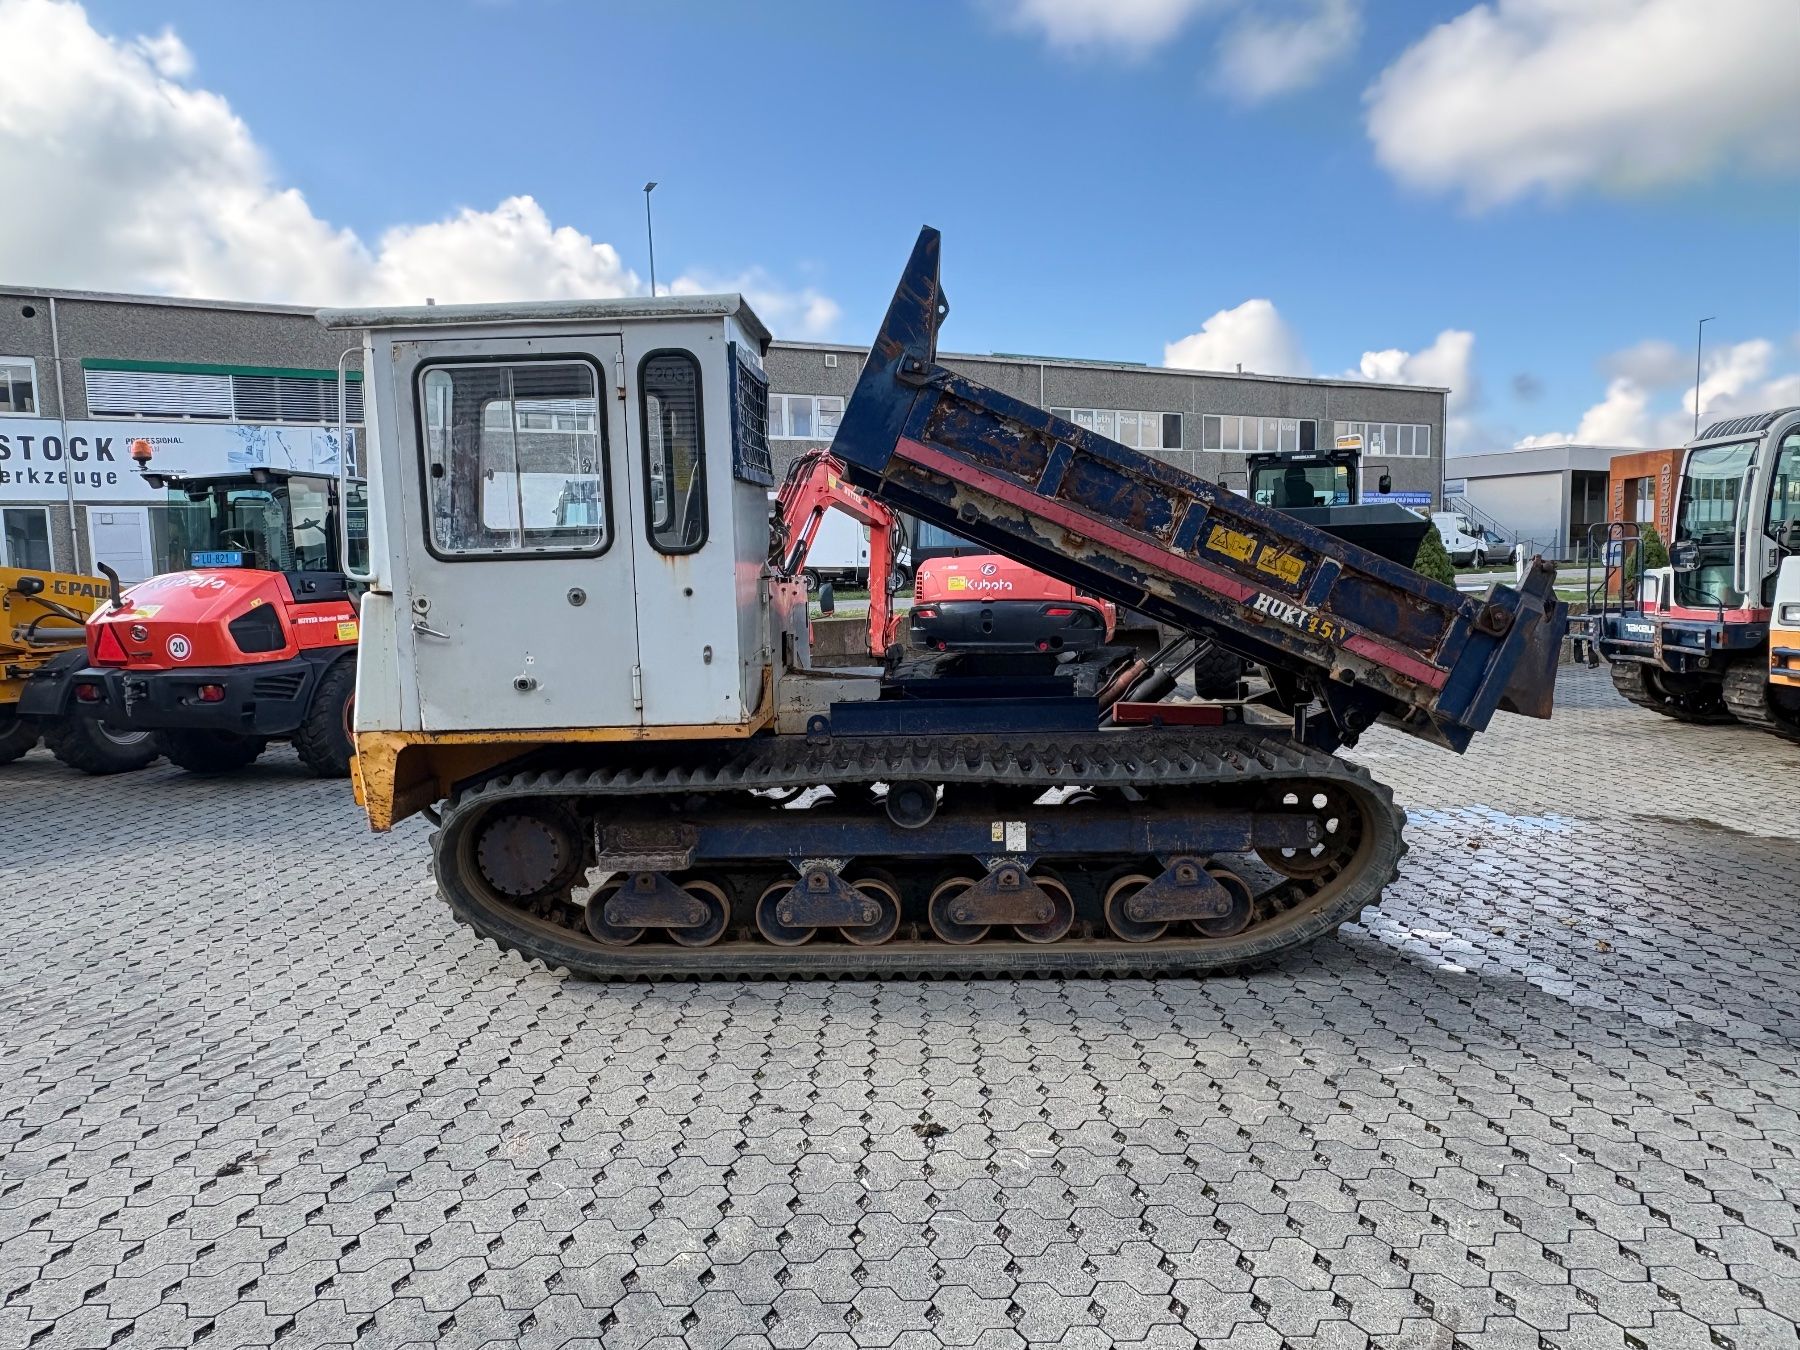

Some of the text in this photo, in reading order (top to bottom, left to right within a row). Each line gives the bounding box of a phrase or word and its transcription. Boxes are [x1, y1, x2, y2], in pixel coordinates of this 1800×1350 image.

[0, 435, 115, 461] STOCK
[0, 467, 117, 488] erkzeuge
[965, 578, 1013, 590] Kubota
[1253, 592, 1309, 628] HUKI
[1626, 623, 1655, 633] TAKEU
[173, 641, 185, 653] 20
